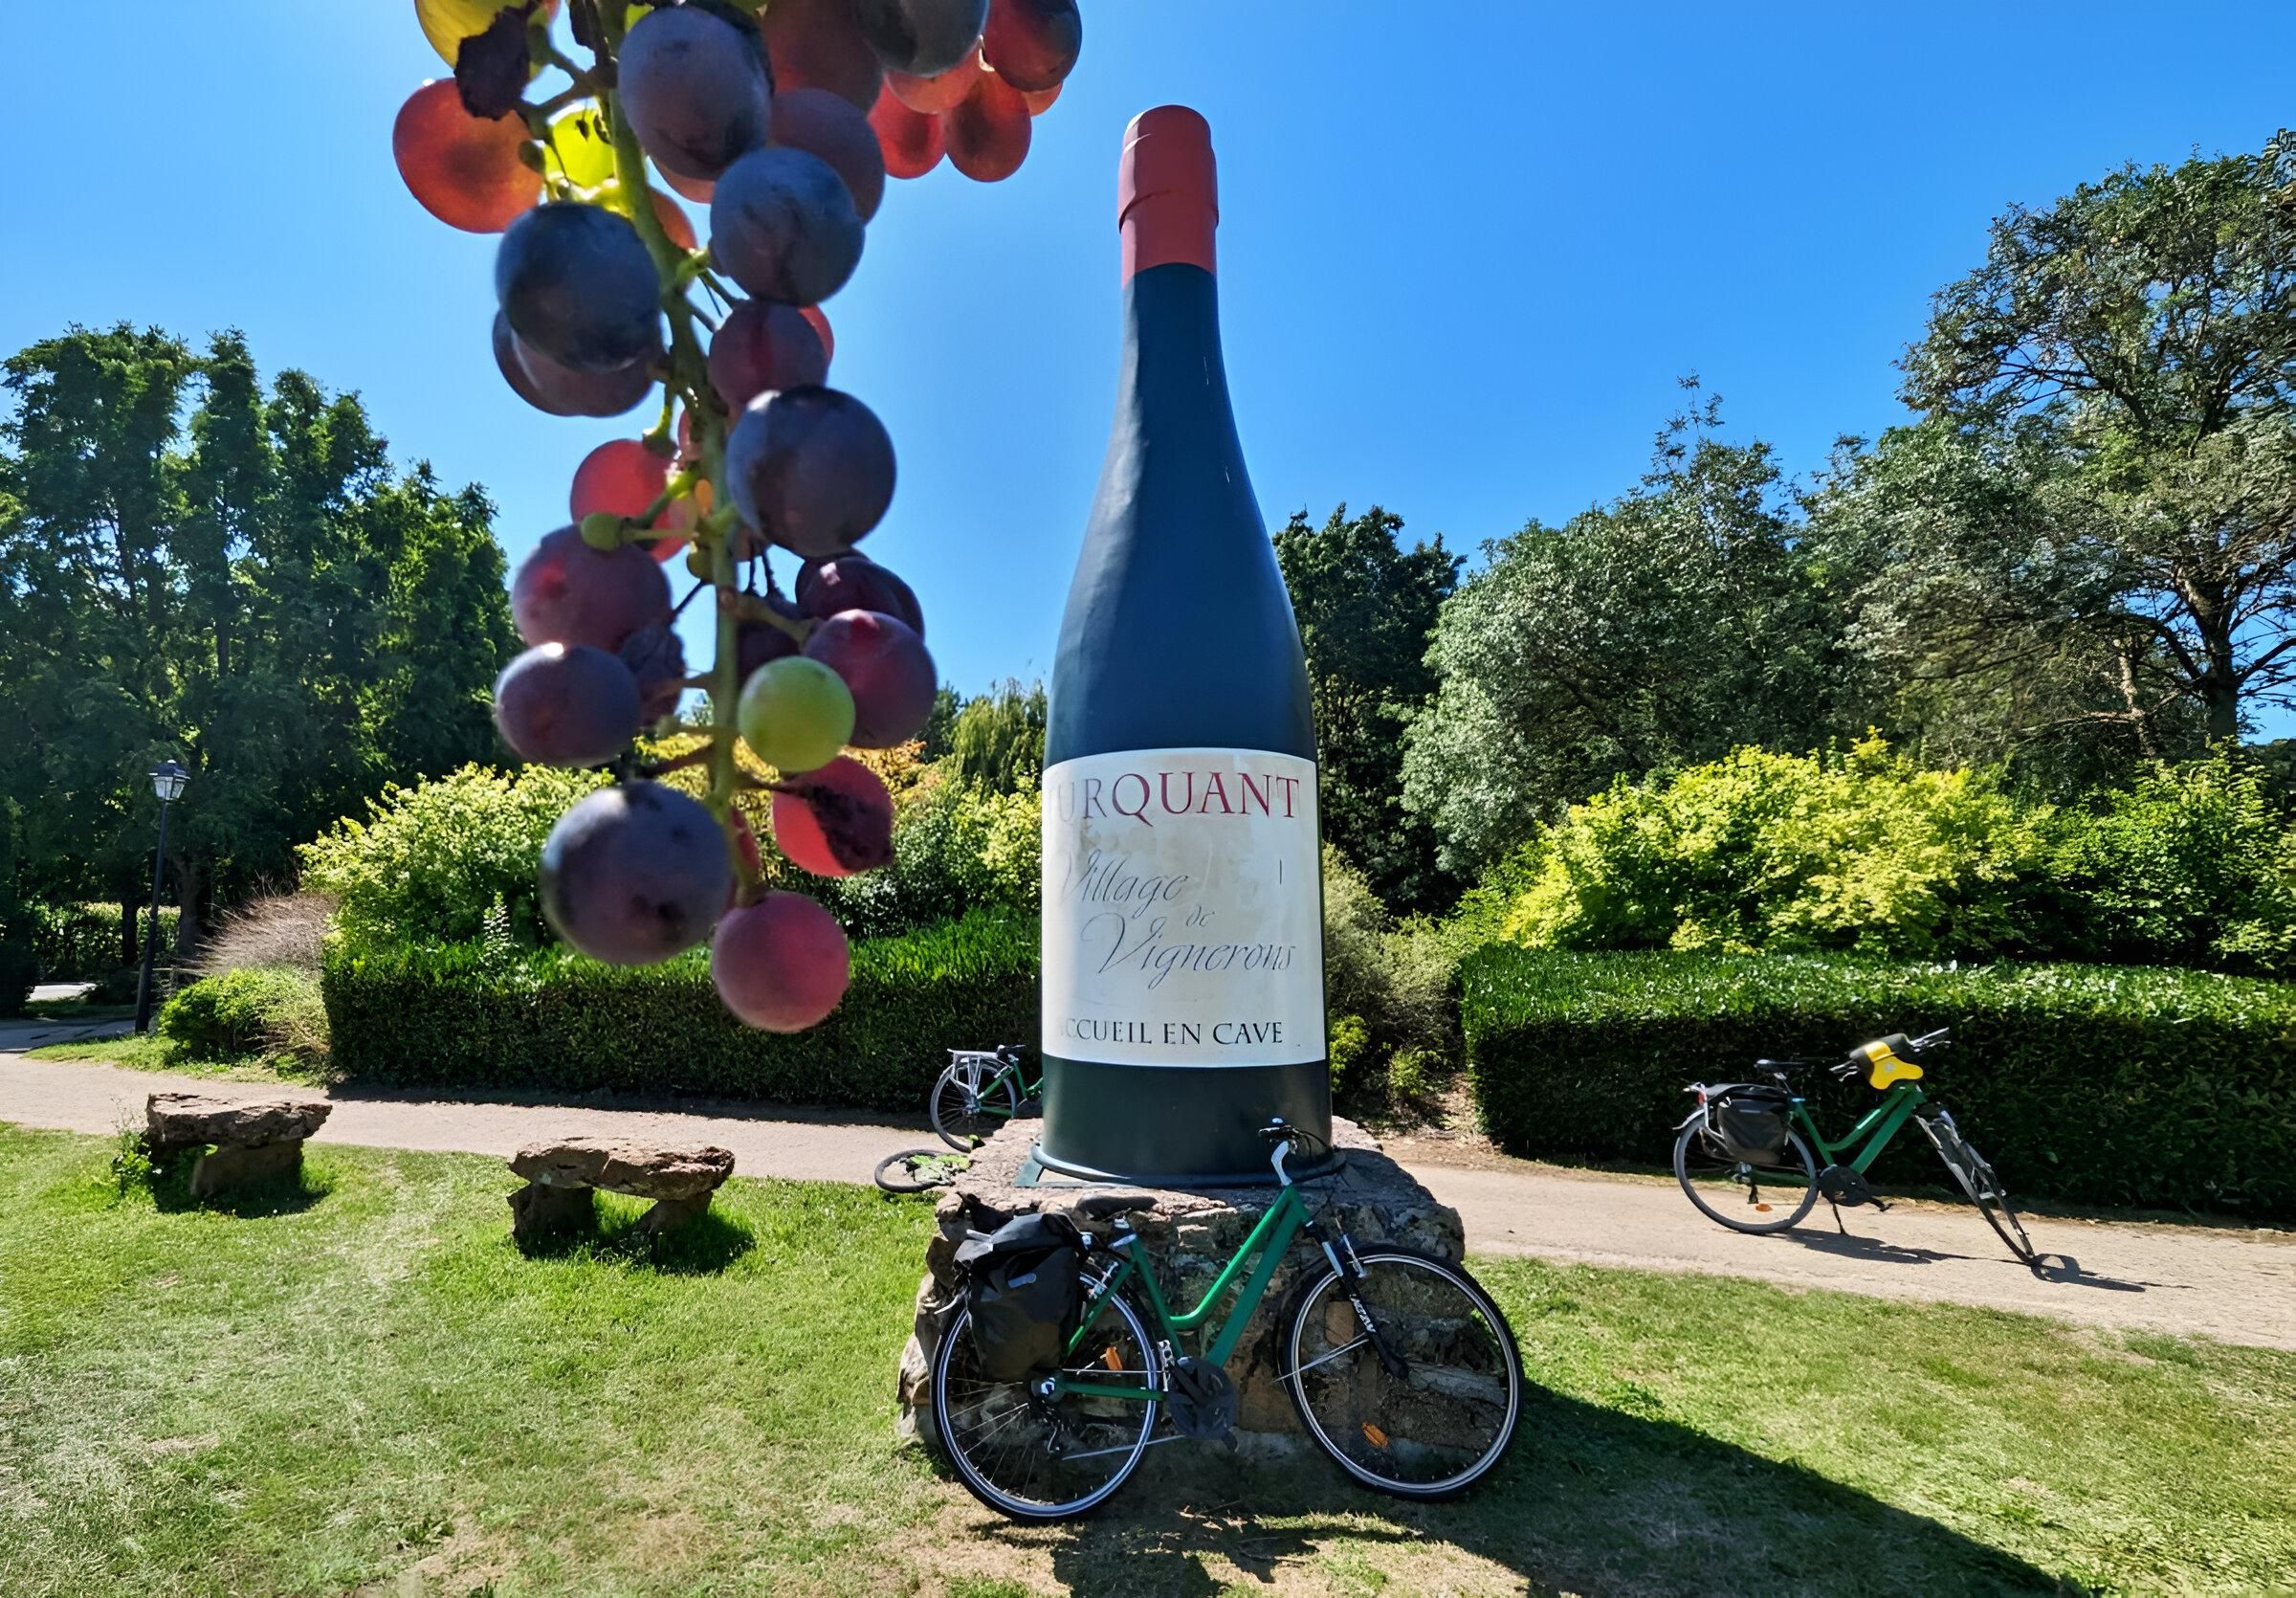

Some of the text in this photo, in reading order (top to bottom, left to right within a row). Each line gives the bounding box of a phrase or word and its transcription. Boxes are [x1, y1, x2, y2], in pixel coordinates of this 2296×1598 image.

[1057, 770, 1299, 827] URQUANT
[1060, 849, 1189, 919] Village
[1186, 905, 1215, 927] de
[1080, 912, 1295, 989] Vignerons
[1061, 1018, 1284, 1044] CCUEIL EN CAVE
